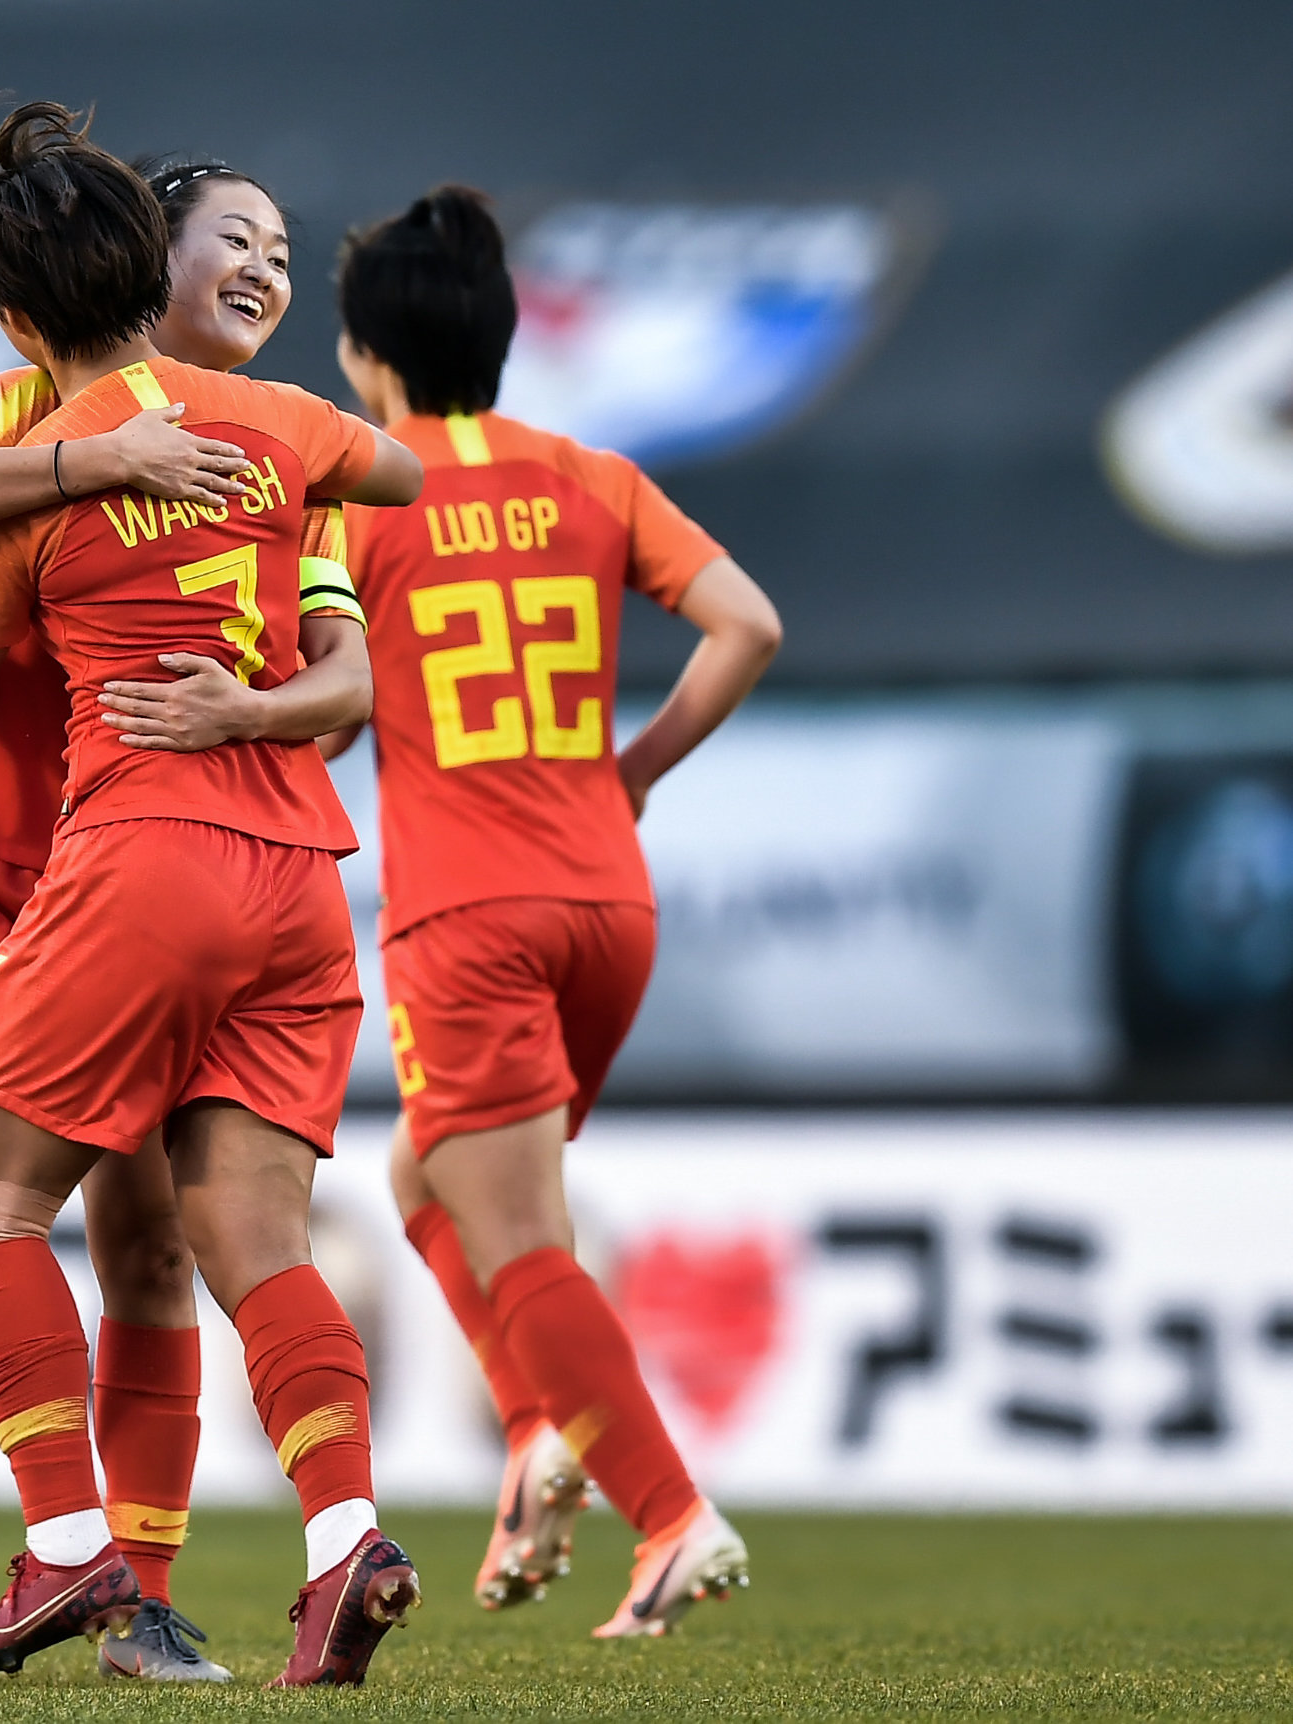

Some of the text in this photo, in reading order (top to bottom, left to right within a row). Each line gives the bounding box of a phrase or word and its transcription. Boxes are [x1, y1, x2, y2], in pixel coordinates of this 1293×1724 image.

[229, 456, 287, 515] SH
[425, 496, 560, 557] LUO GP
[174, 542, 265, 686] 7
[409, 575, 604, 770] 22
